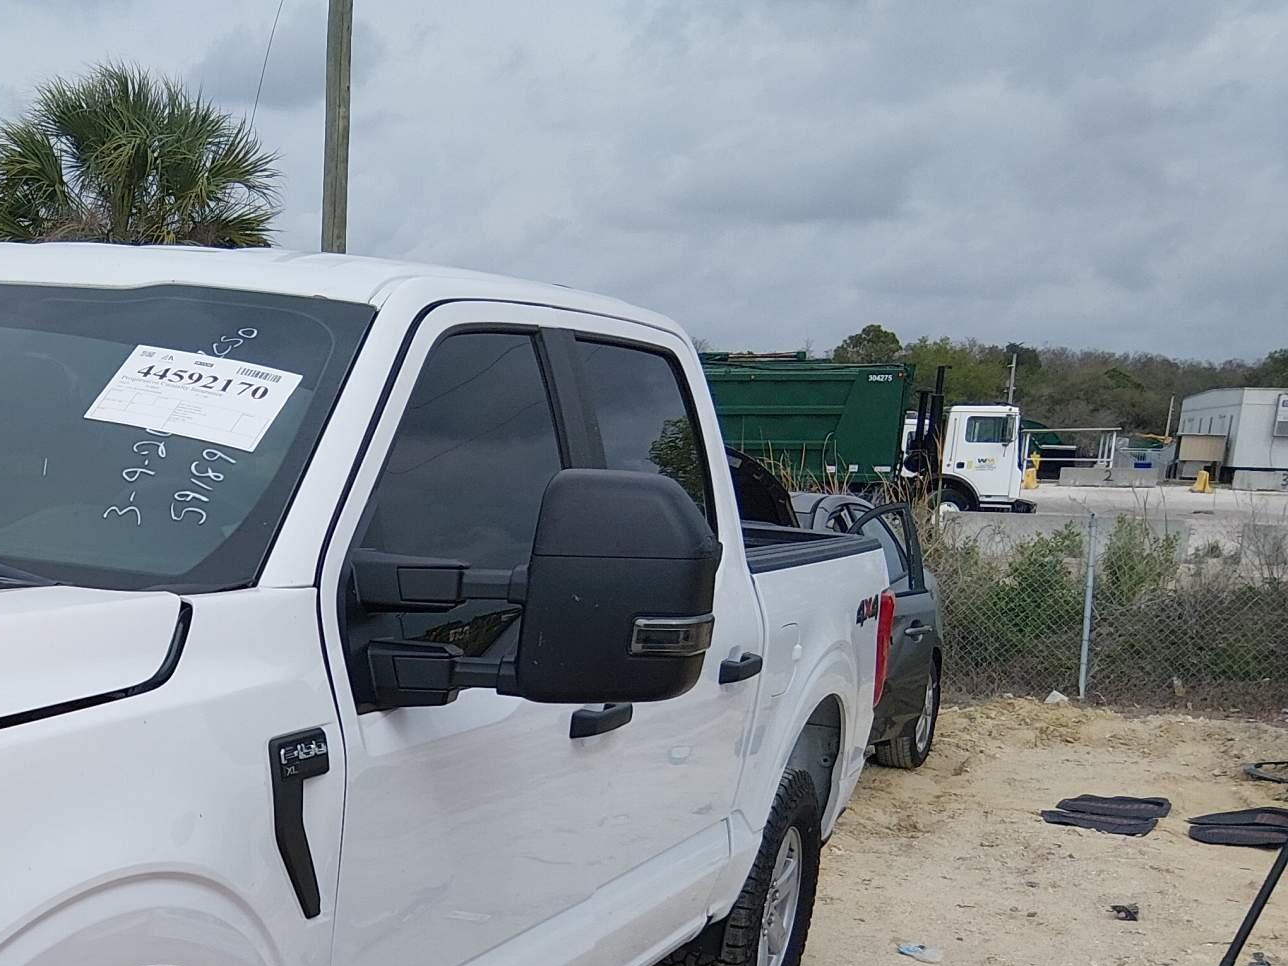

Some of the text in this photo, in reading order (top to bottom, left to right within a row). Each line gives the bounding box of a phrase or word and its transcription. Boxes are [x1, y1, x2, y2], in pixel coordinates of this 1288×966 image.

[137, 365, 269, 400] 44592170
[868, 374, 893, 382] 304275
[170, 448, 237, 525] 59189
